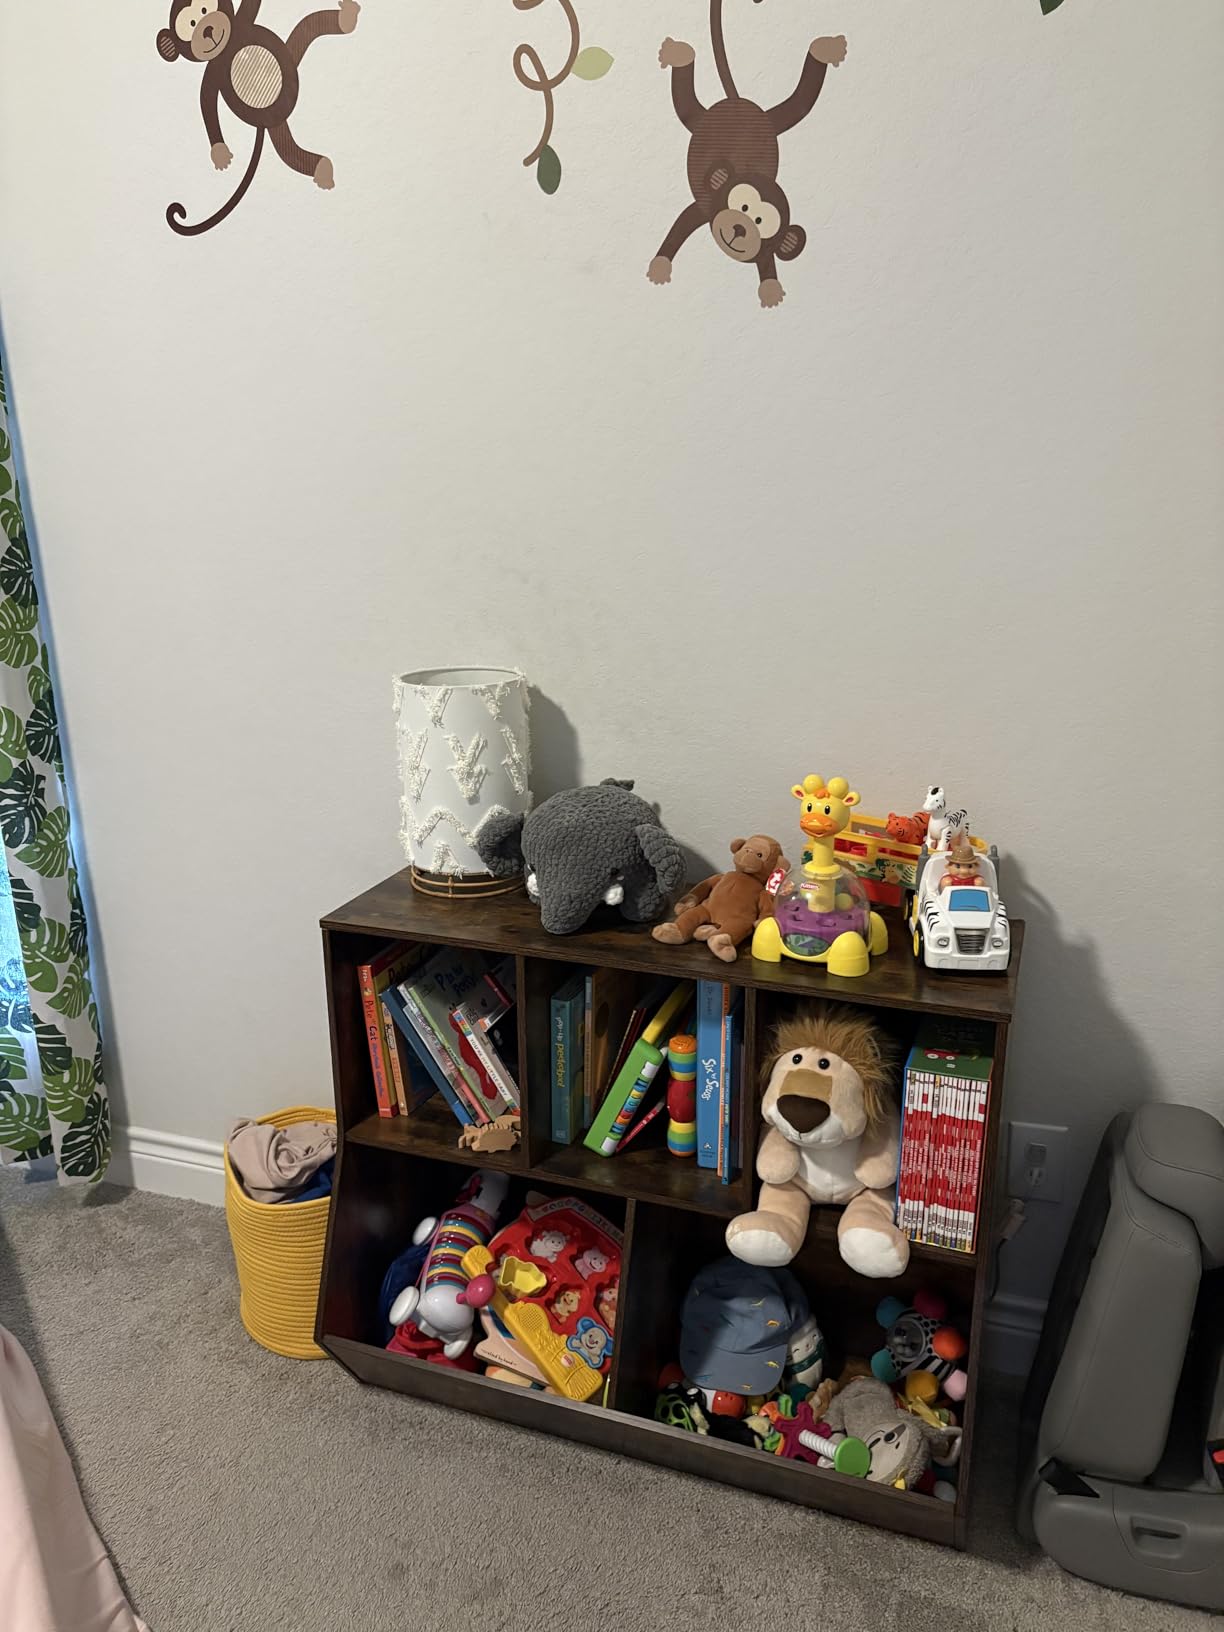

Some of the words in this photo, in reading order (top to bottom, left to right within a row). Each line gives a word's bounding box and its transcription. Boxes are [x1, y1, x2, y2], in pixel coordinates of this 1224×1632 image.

[370, 1025, 378, 1041] Cat
[701, 1058, 717, 1074] Six
[701, 1078, 719, 1101] Seuss
